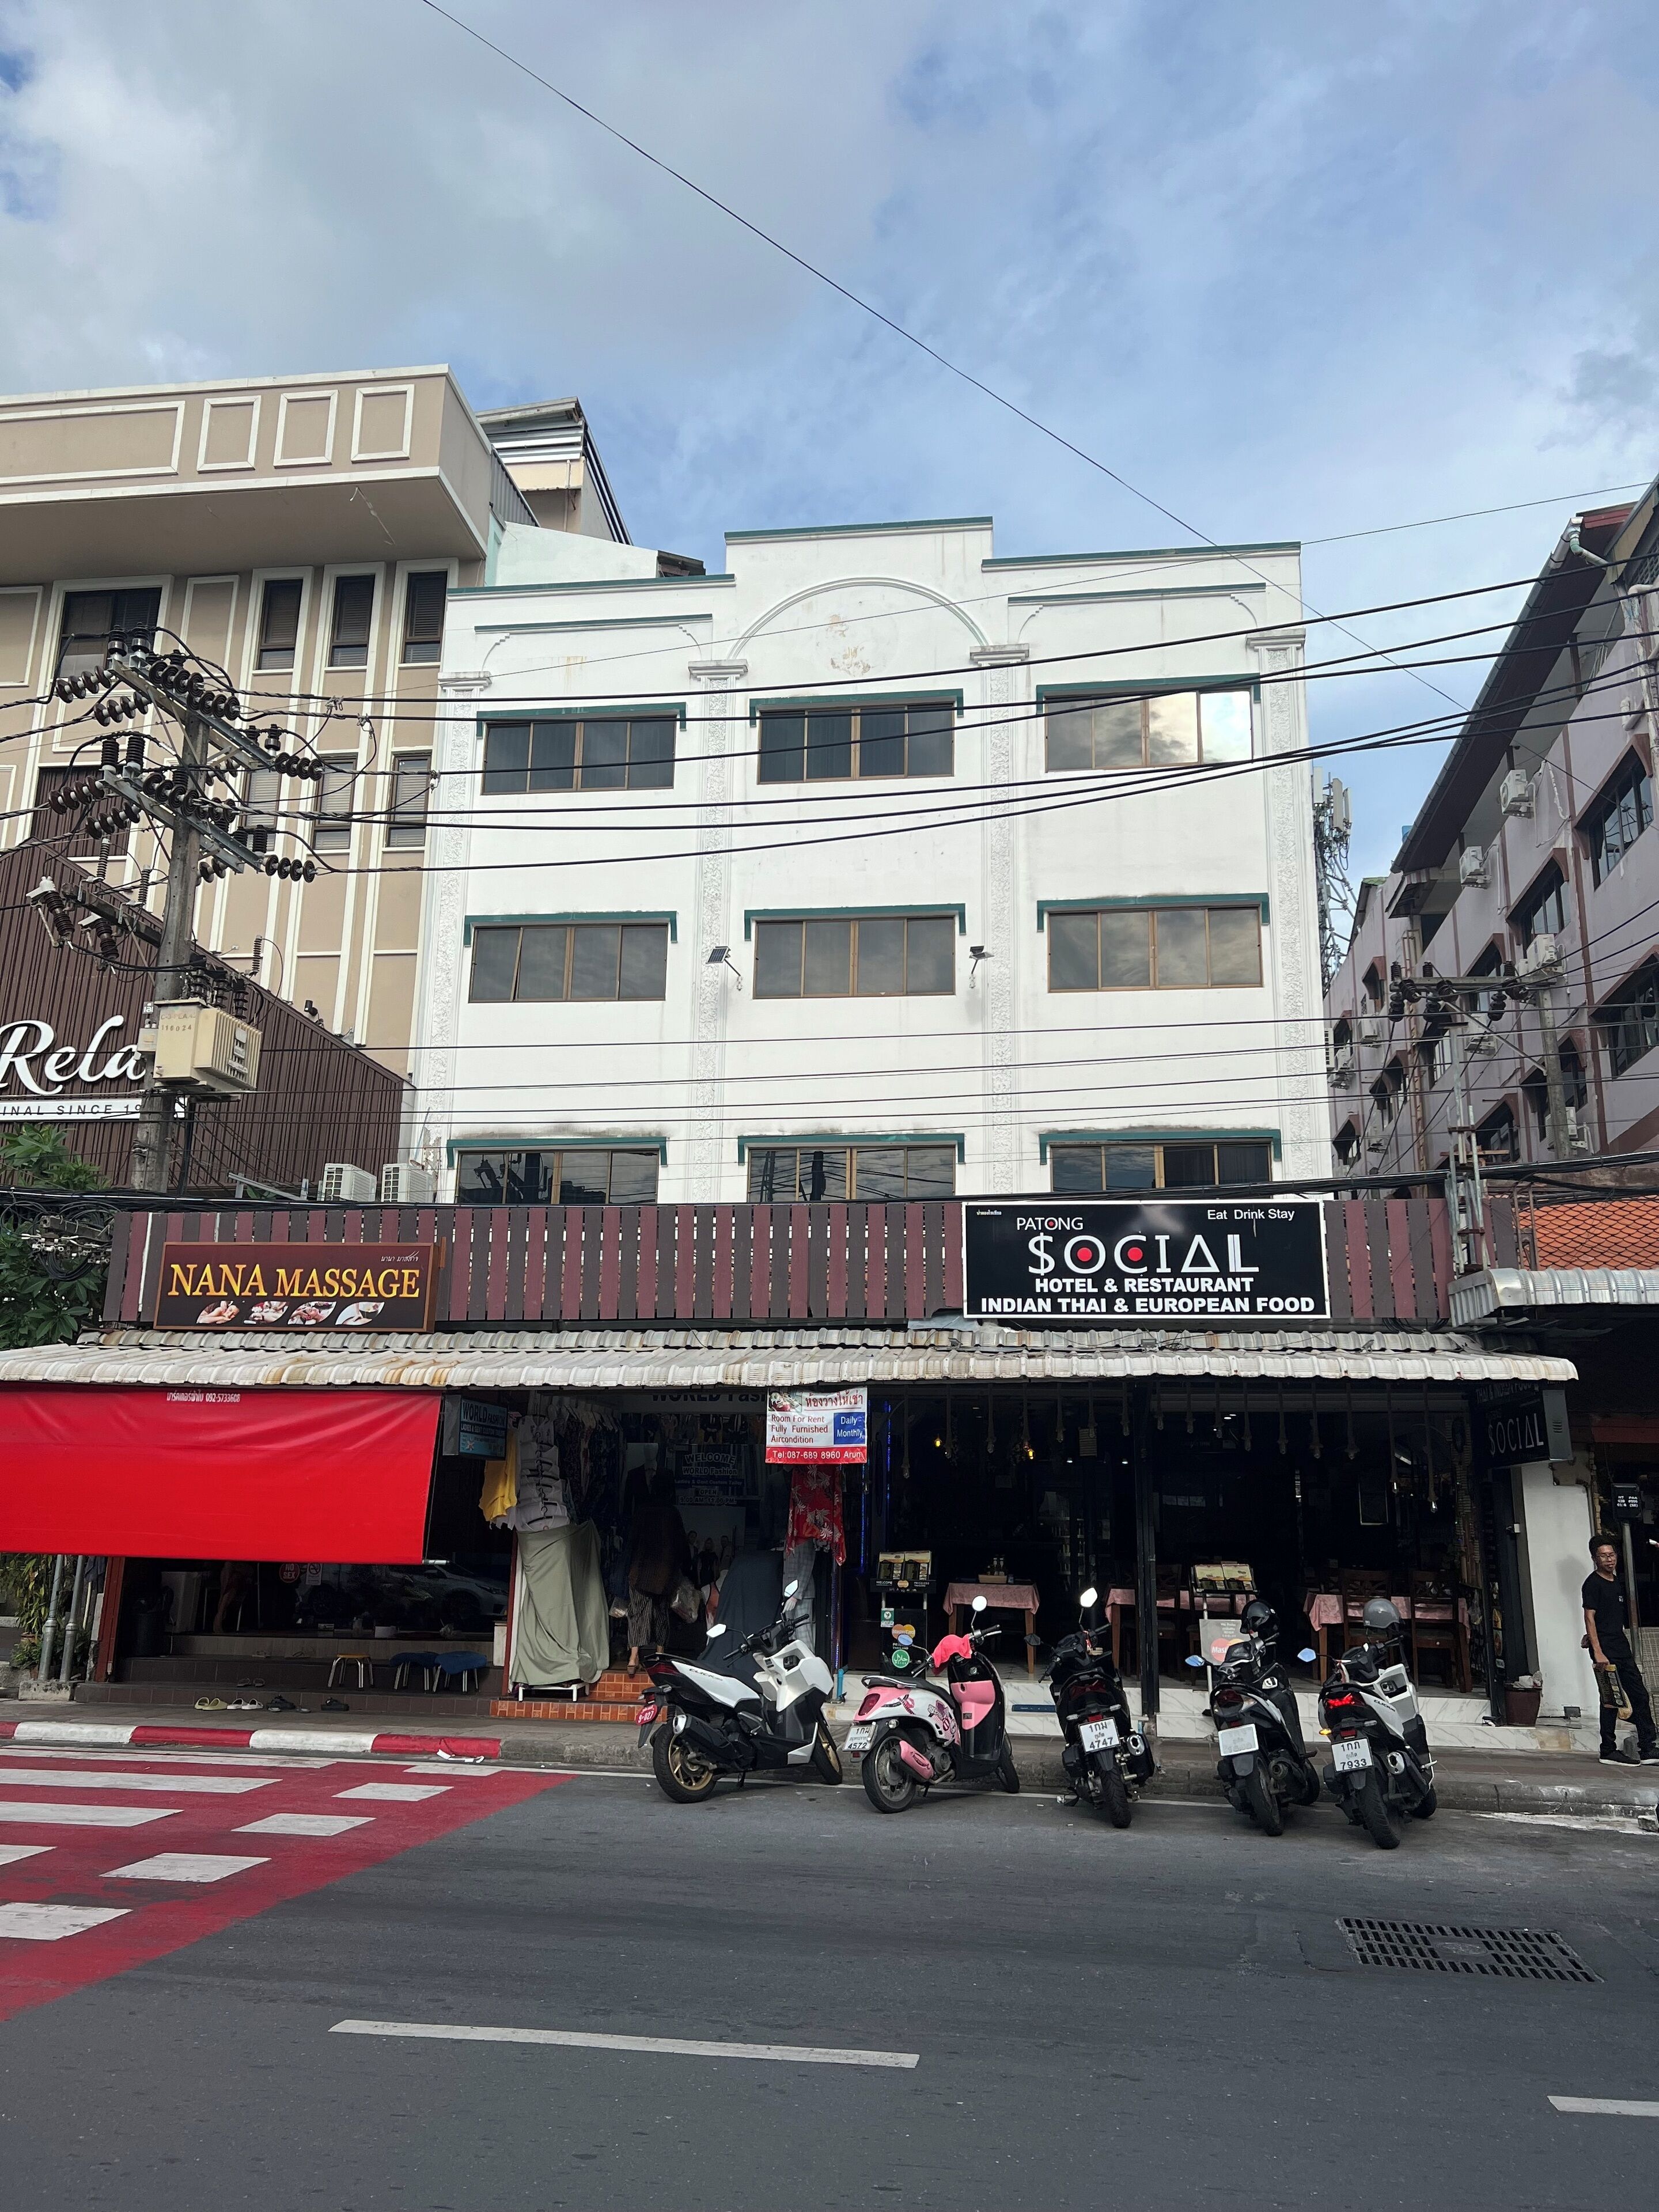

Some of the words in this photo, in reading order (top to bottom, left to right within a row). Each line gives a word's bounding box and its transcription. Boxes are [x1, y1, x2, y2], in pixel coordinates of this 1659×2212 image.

[57, 1105, 112, 1115] SINCE
[1208, 1210, 1228, 1219] Eat
[1234, 1209, 1265, 1219] Drink
[1268, 1209, 1294, 1221] Stay
[1017, 1217, 1083, 1230] PATONG
[168, 1264, 267, 1296] NANA
[274, 1269, 420, 1298] MASSAGE
[1036, 1278, 1098, 1293] HOTEL
[1104, 1278, 1118, 1293] &
[1124, 1278, 1253, 1293] RESTAURANT
[982, 1298, 1051, 1312] INDIAN
[1058, 1298, 1106, 1312] THAI
[1114, 1298, 1128, 1312] &
[1136, 1298, 1249, 1312] EUROPEAN
[1257, 1297, 1314, 1312] FOOD
[463, 1403, 487, 1422] WORLD
[771, 1414, 791, 1422] Room
[840, 1416, 857, 1426] Daily
[771, 1425, 787, 1434] Fully
[792, 1425, 828, 1433] Furnished
[836, 1429, 863, 1438] Monthly
[771, 1435, 813, 1444] Aircondition
[684, 1452, 736, 1465] WELCOME
[843, 1450, 862, 1459] Arun
[683, 1467, 709, 1475] WORLD
[710, 1467, 737, 1475] Fashion
[285, 1563, 294, 1571] NO
[1089, 1737, 1113, 1749] 4747
[1340, 1758, 1367, 1770] 7933
